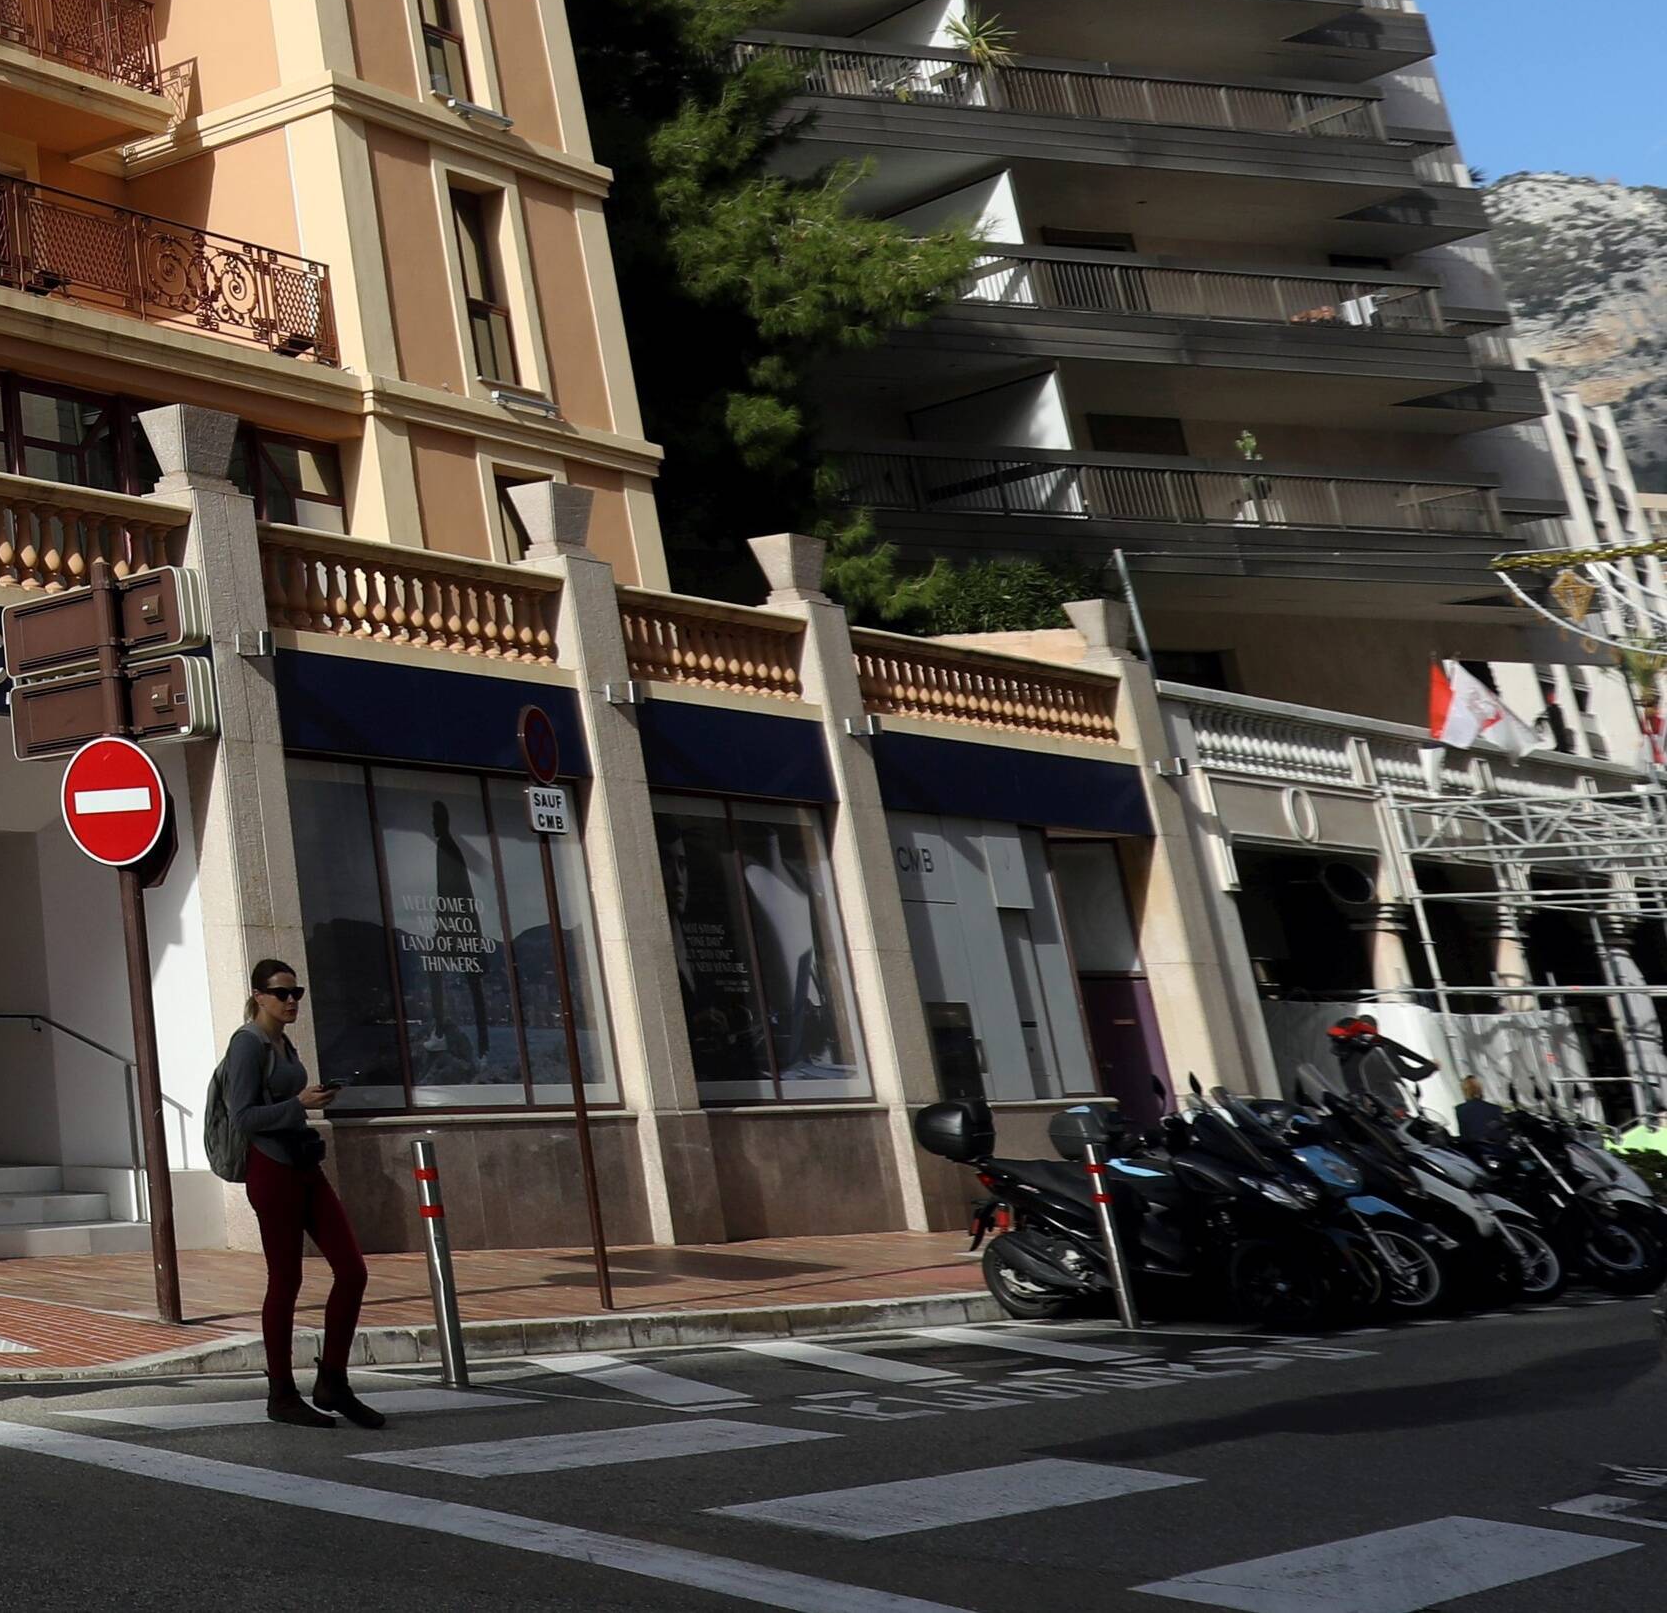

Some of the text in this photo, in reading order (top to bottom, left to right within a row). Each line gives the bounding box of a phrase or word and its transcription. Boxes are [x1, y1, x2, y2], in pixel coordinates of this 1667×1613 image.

[533, 792, 562, 809] SAUF
[537, 813, 564, 830] CMB
[896, 846, 934, 873] CMB
[402, 894, 484, 914] WELCOME TO
[417, 915, 477, 933] MONACO.
[401, 934, 496, 954] LAND OF AHEAD
[419, 955, 484, 973] THINKERS.
